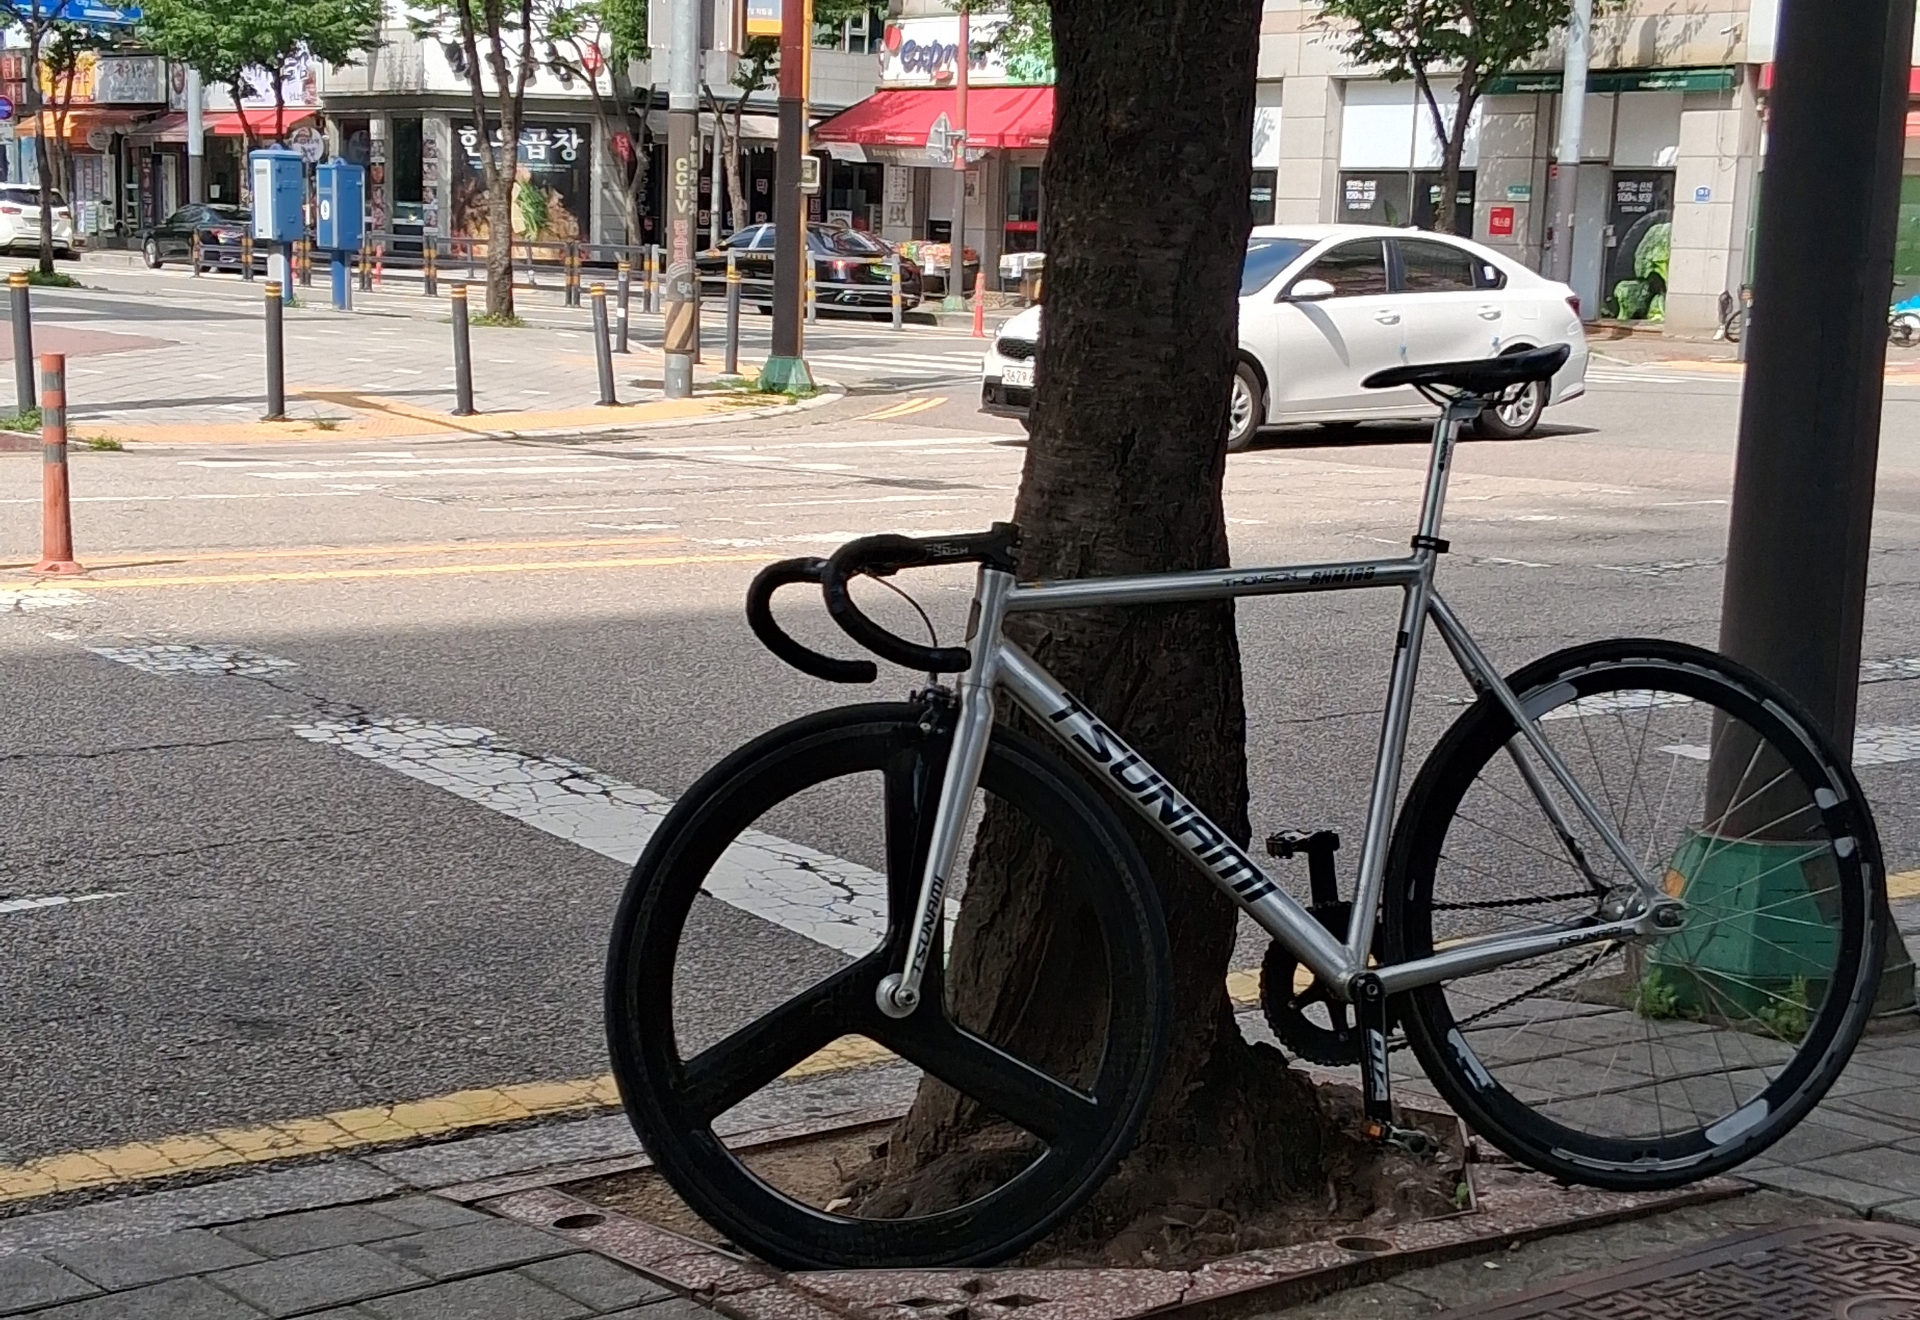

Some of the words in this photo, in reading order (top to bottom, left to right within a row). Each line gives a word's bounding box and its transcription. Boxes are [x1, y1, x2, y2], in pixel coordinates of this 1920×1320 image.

[900, 39, 988, 74] expr
[675, 157, 688, 214] CCTV
[1049, 691, 1279, 903] TSUNAMI
[911, 874, 945, 974] TSUNAMI
